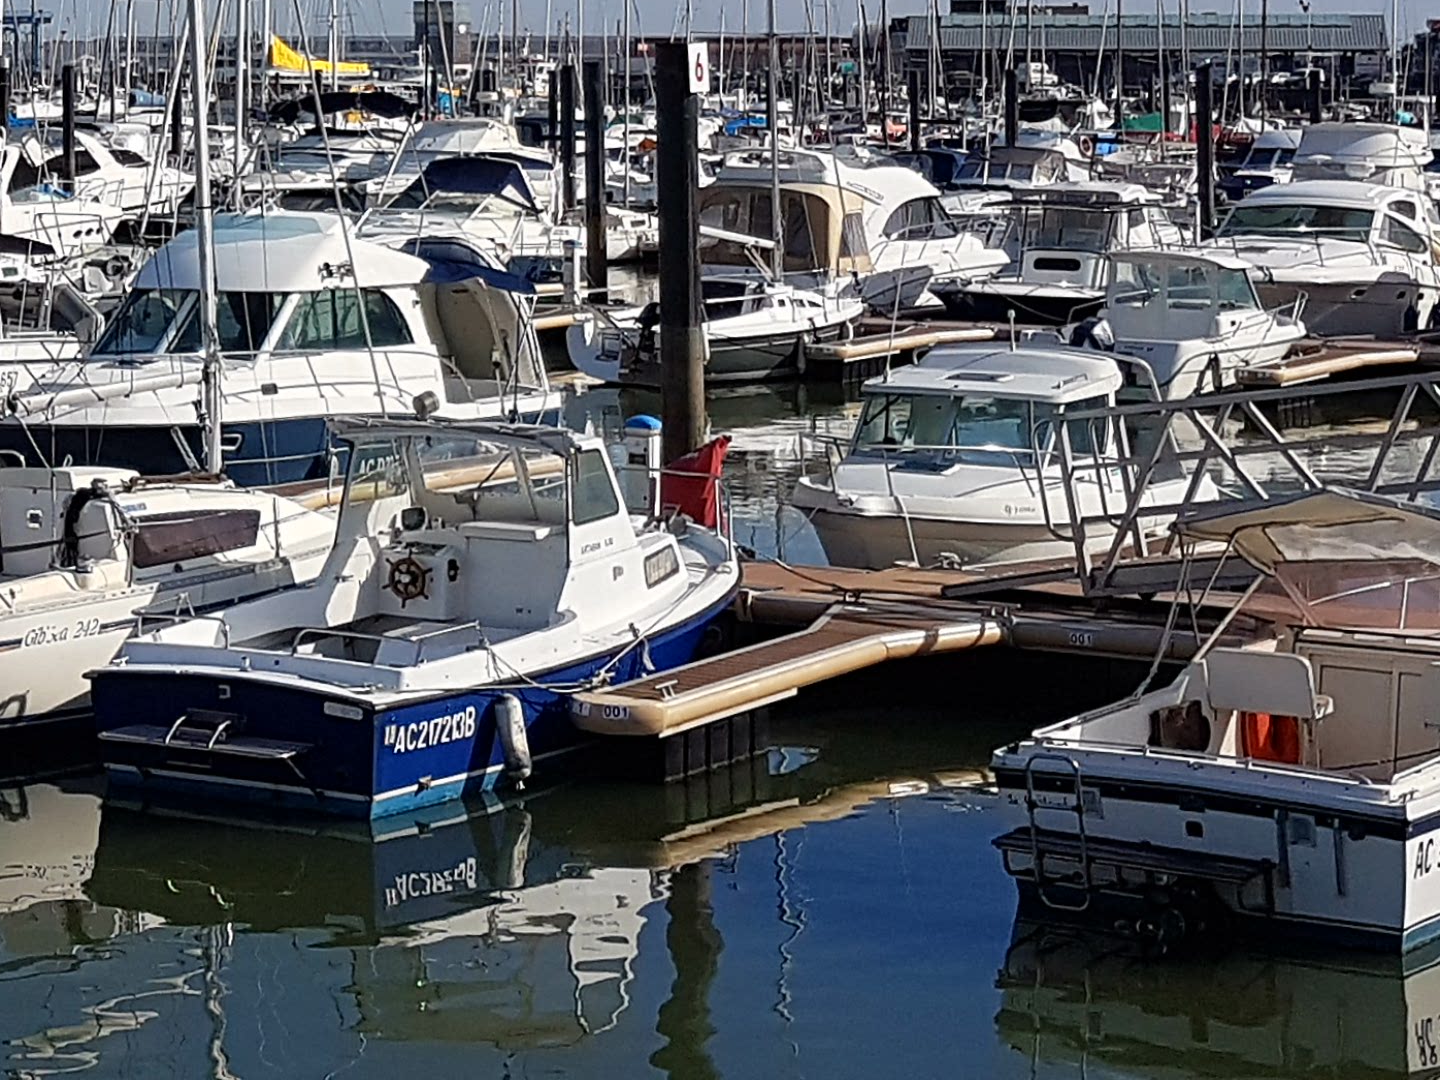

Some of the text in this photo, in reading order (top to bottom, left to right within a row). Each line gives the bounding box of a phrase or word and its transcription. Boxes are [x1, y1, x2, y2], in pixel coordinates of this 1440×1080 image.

[695, 52, 703, 82] 6
[73, 618, 99, 639] 242
[1070, 633, 1091, 644] 001
[604, 705, 627, 718] 001
[1414, 838, 1434, 880] AC
